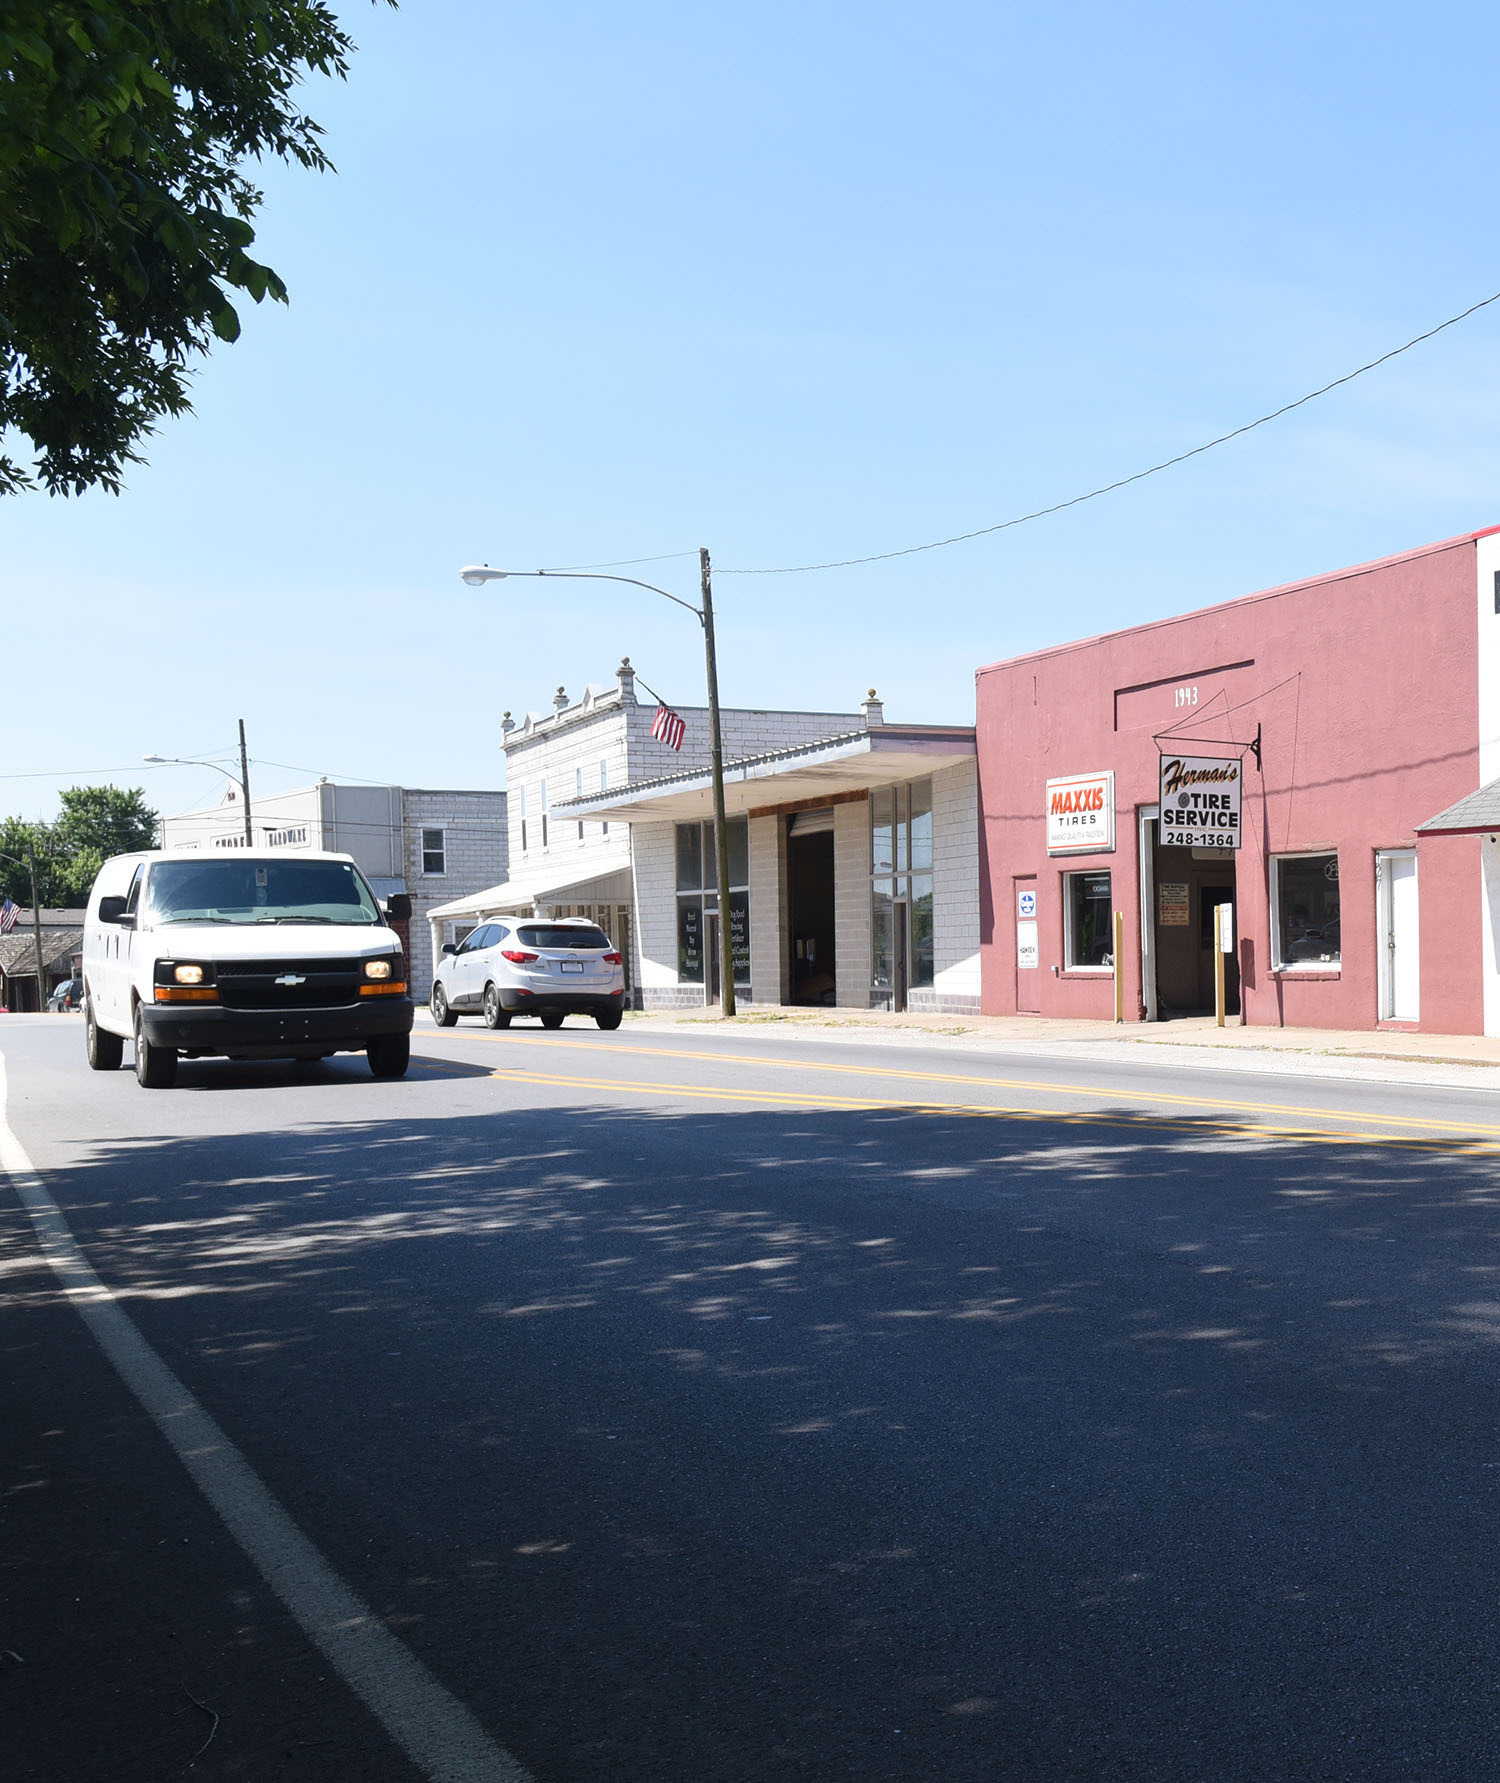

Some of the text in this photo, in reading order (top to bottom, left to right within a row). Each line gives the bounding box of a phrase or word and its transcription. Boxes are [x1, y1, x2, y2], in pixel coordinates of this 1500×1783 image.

[1174, 686, 1198, 708] 1943
[1162, 760, 1238, 796] Herman's
[1050, 786, 1104, 815] MAXXIS
[1190, 793, 1231, 810] TIRE
[1058, 815, 1096, 827] TIRES
[1163, 809, 1238, 828] SERVICE
[1167, 832, 1234, 846] 248-1364
